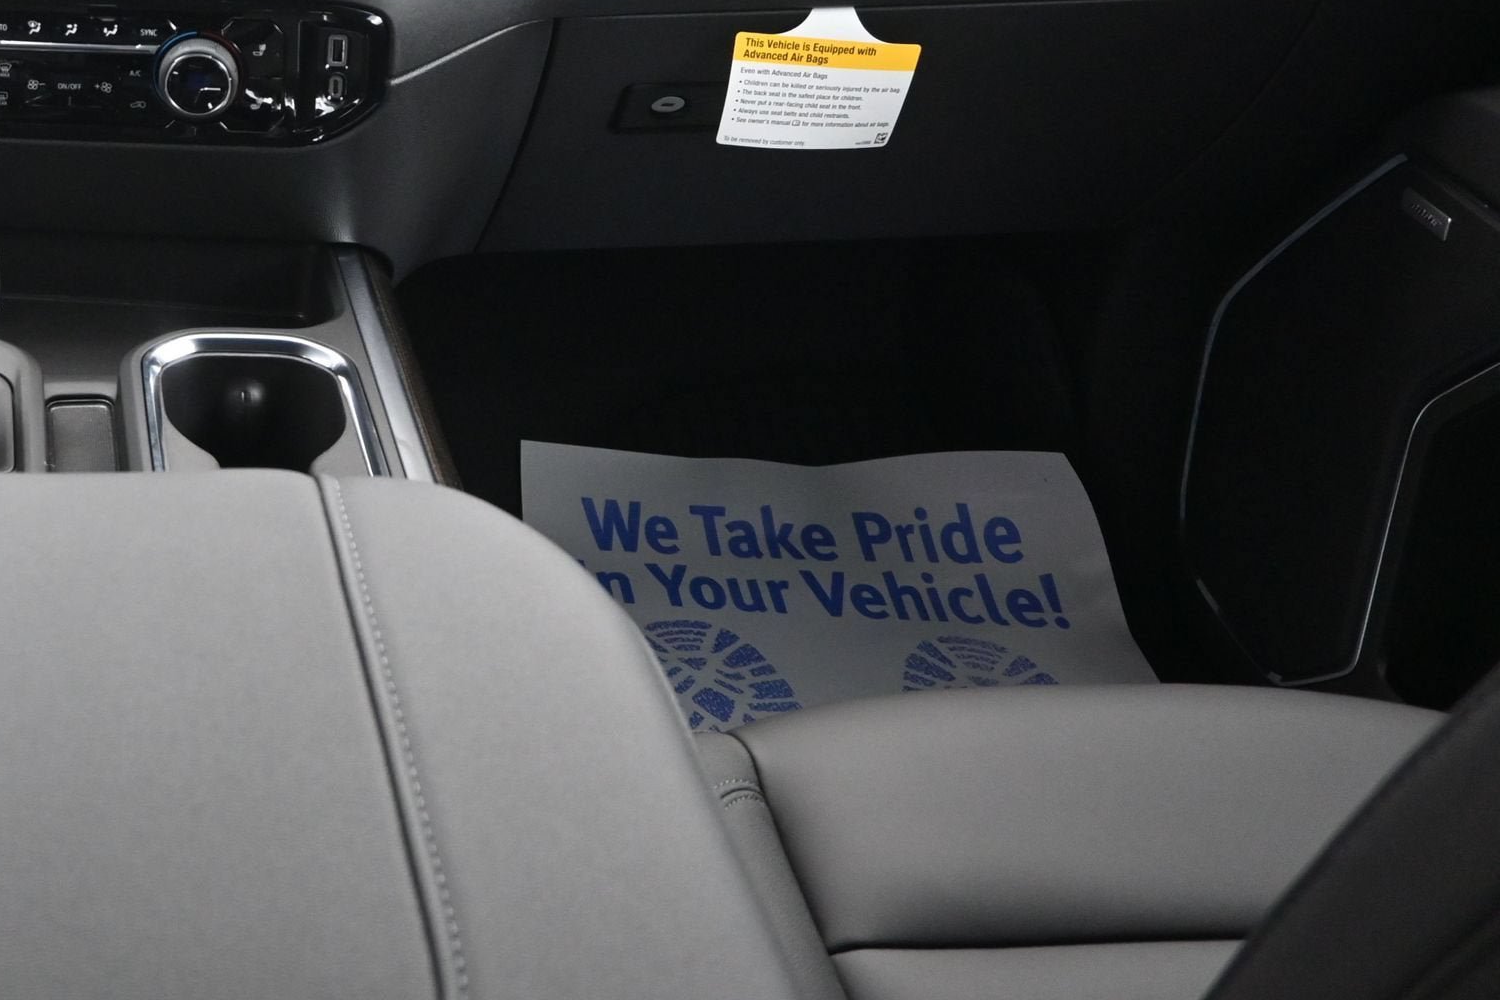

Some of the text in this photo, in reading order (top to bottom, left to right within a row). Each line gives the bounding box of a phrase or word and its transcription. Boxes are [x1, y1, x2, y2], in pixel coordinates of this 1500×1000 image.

[140, 28, 158, 37] SYNC
[746, 37, 877, 56] This Vehicle is Equipped with
[743, 49, 829, 65] Advanced Air Bags
[130, 70, 141, 78] A/C
[813, 72, 828, 80] Bags
[57, 82, 82, 90] ON/OFF
[581, 497, 1026, 565] We Take Pride
[578, 559, 1071, 631] n Your Vehicle!
